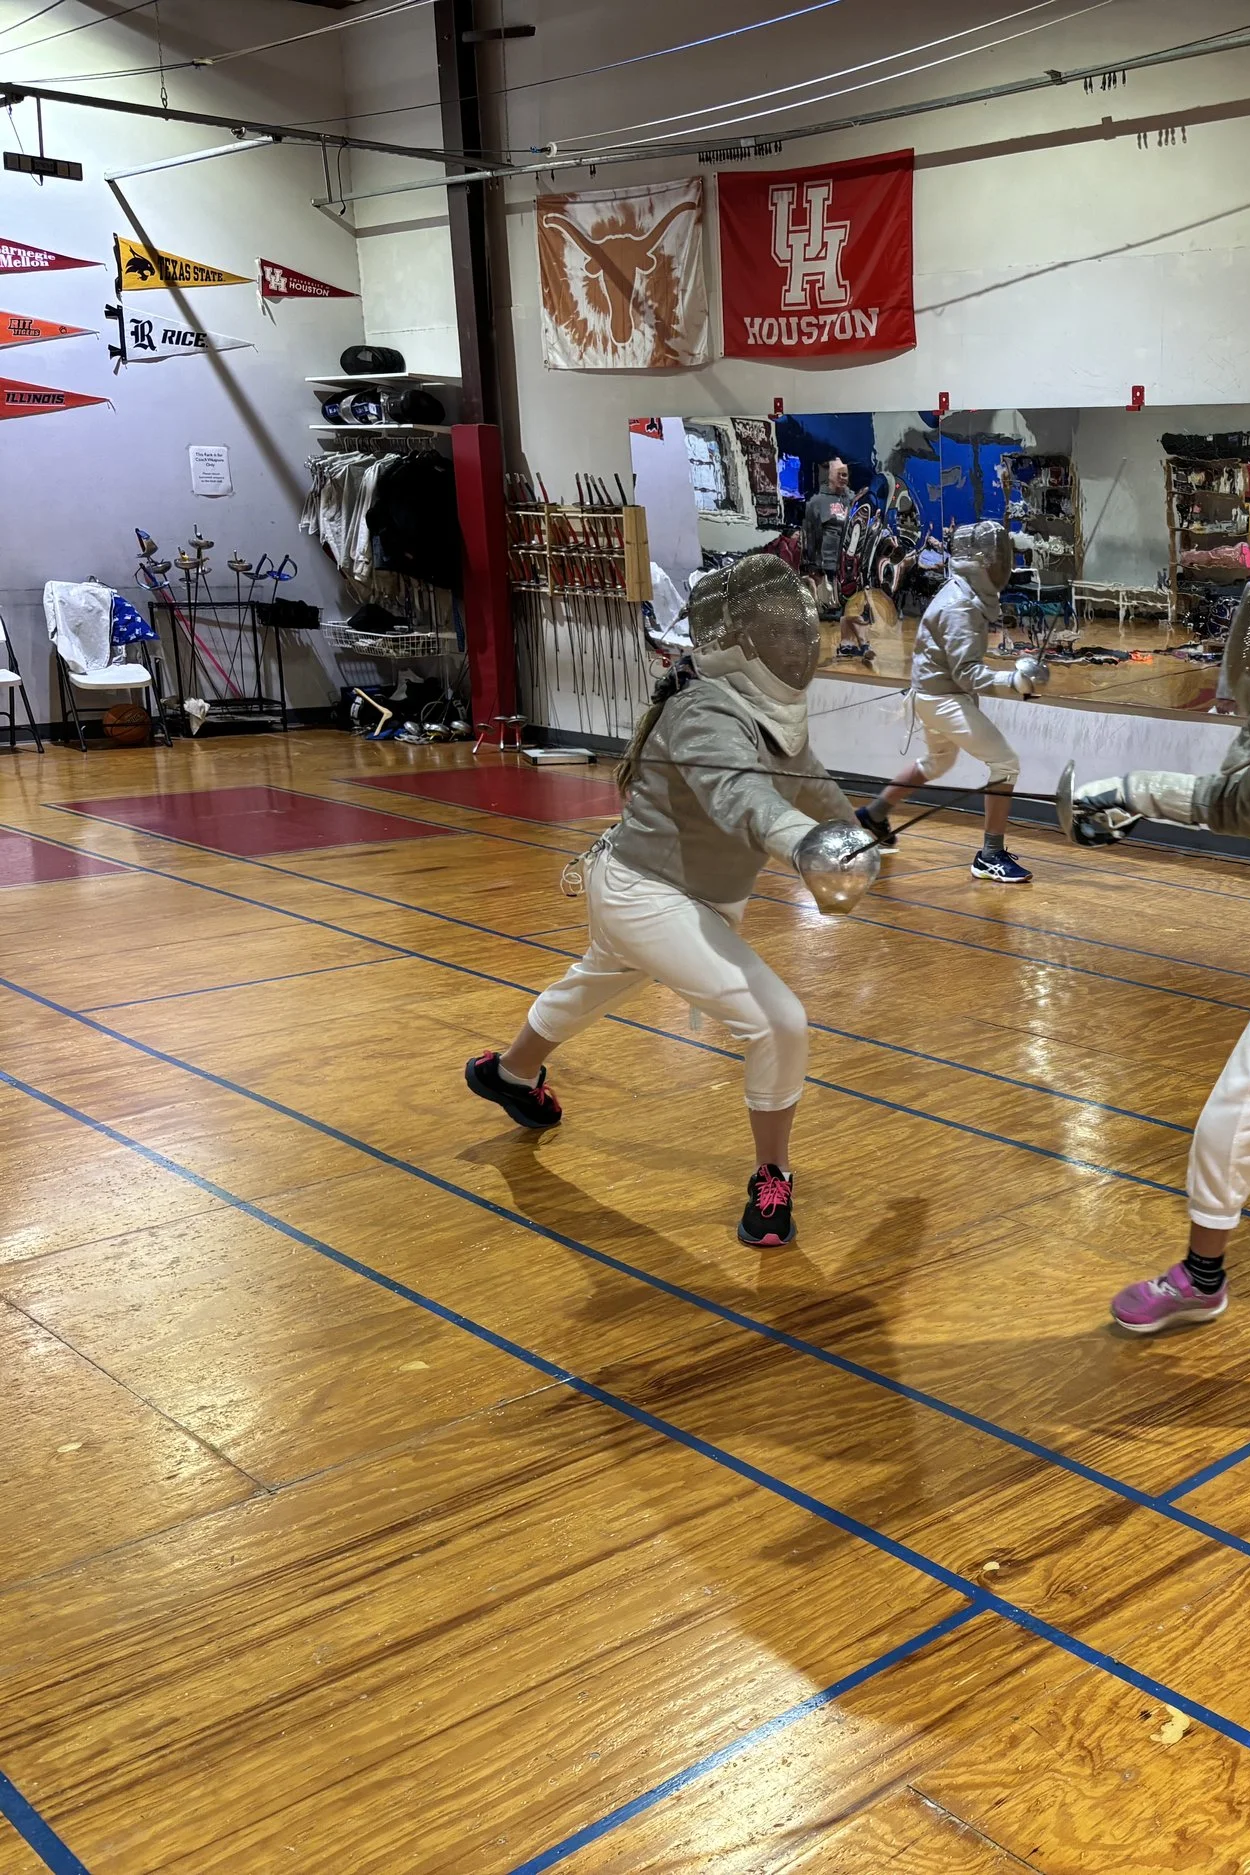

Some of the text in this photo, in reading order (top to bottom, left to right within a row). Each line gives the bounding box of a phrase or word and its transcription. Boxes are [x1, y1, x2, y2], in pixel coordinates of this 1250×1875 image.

[0, 244, 56, 261] arnegie
[0, 253, 50, 268] Mellon
[158, 255, 223, 282] TEXAS STATE
[289, 281, 330, 297] HOUSTON
[8, 318, 33, 329] RIT
[743, 307, 880, 345] HOUSTON
[13, 328, 40, 337] TIGERS
[161, 328, 208, 348] RICE
[5, 392, 65, 405] ILLINOIS
